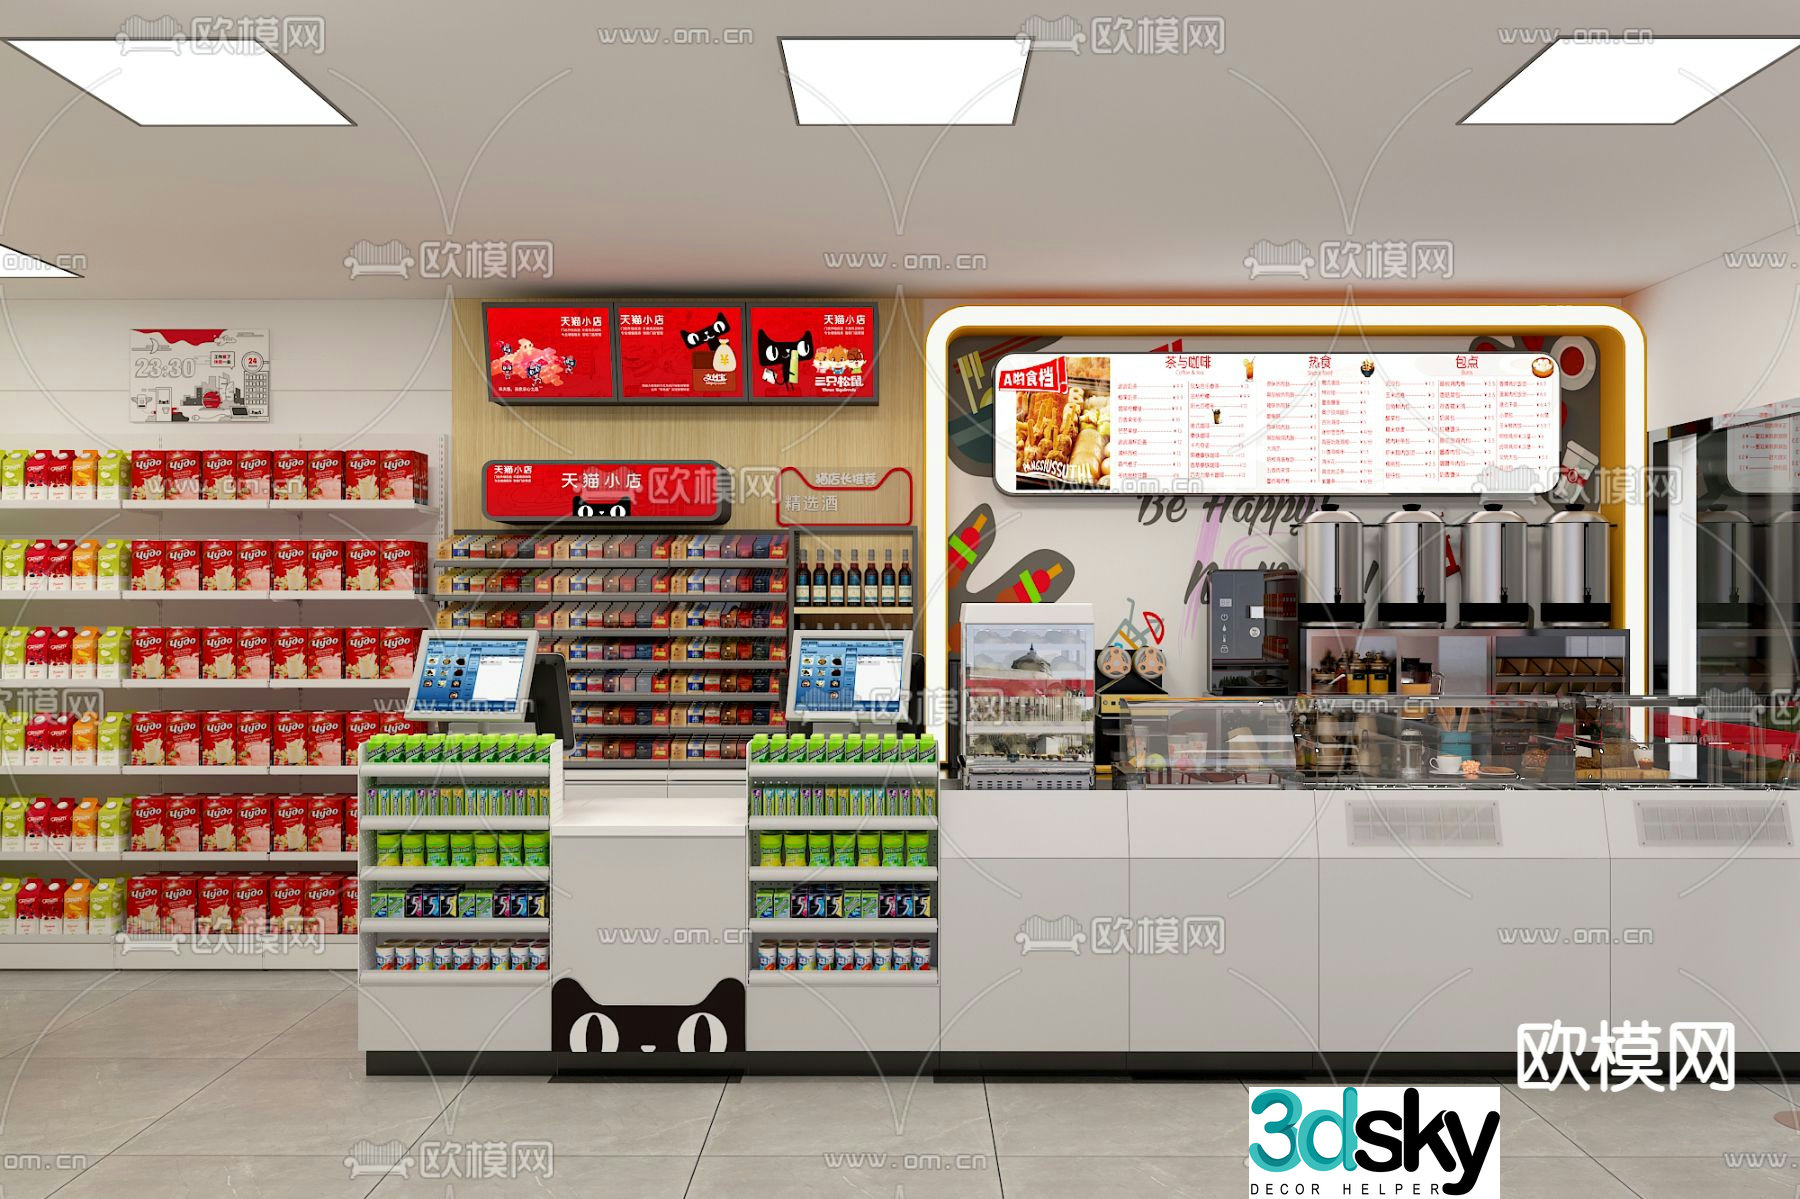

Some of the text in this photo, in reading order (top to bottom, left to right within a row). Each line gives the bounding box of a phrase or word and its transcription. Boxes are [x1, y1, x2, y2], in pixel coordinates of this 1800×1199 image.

[561, 316, 602, 327] 天猫小店
[620, 315, 664, 325] 天猫小店
[824, 315, 866, 325] 天猫小店
[135, 357, 196, 378] 23:30
[1165, 355, 1211, 369] 茶与咖啡
[1308, 355, 1331, 369] 热食
[1456, 355, 1478, 369] 包点
[815, 376, 864, 387] 三只松鼠
[494, 465, 532, 474] 天猫小店
[561, 473, 641, 489] 天猫小店
[785, 495, 838, 512] 精选酒
[1138, 495, 1188, 526] Be
[411, 896, 420, 915] 5
[428, 896, 438, 915] 5
[445, 896, 456, 915] 5
[498, 896, 508, 915] 5
[516, 896, 526, 915] 5
[533, 896, 544, 915] 5
[797, 896, 805, 915] 5
[814, 896, 823, 915] 5
[831, 896, 840, 915] 5
[884, 896, 893, 915] 5
[901, 896, 910, 915] 5
[919, 896, 928, 915] 5
